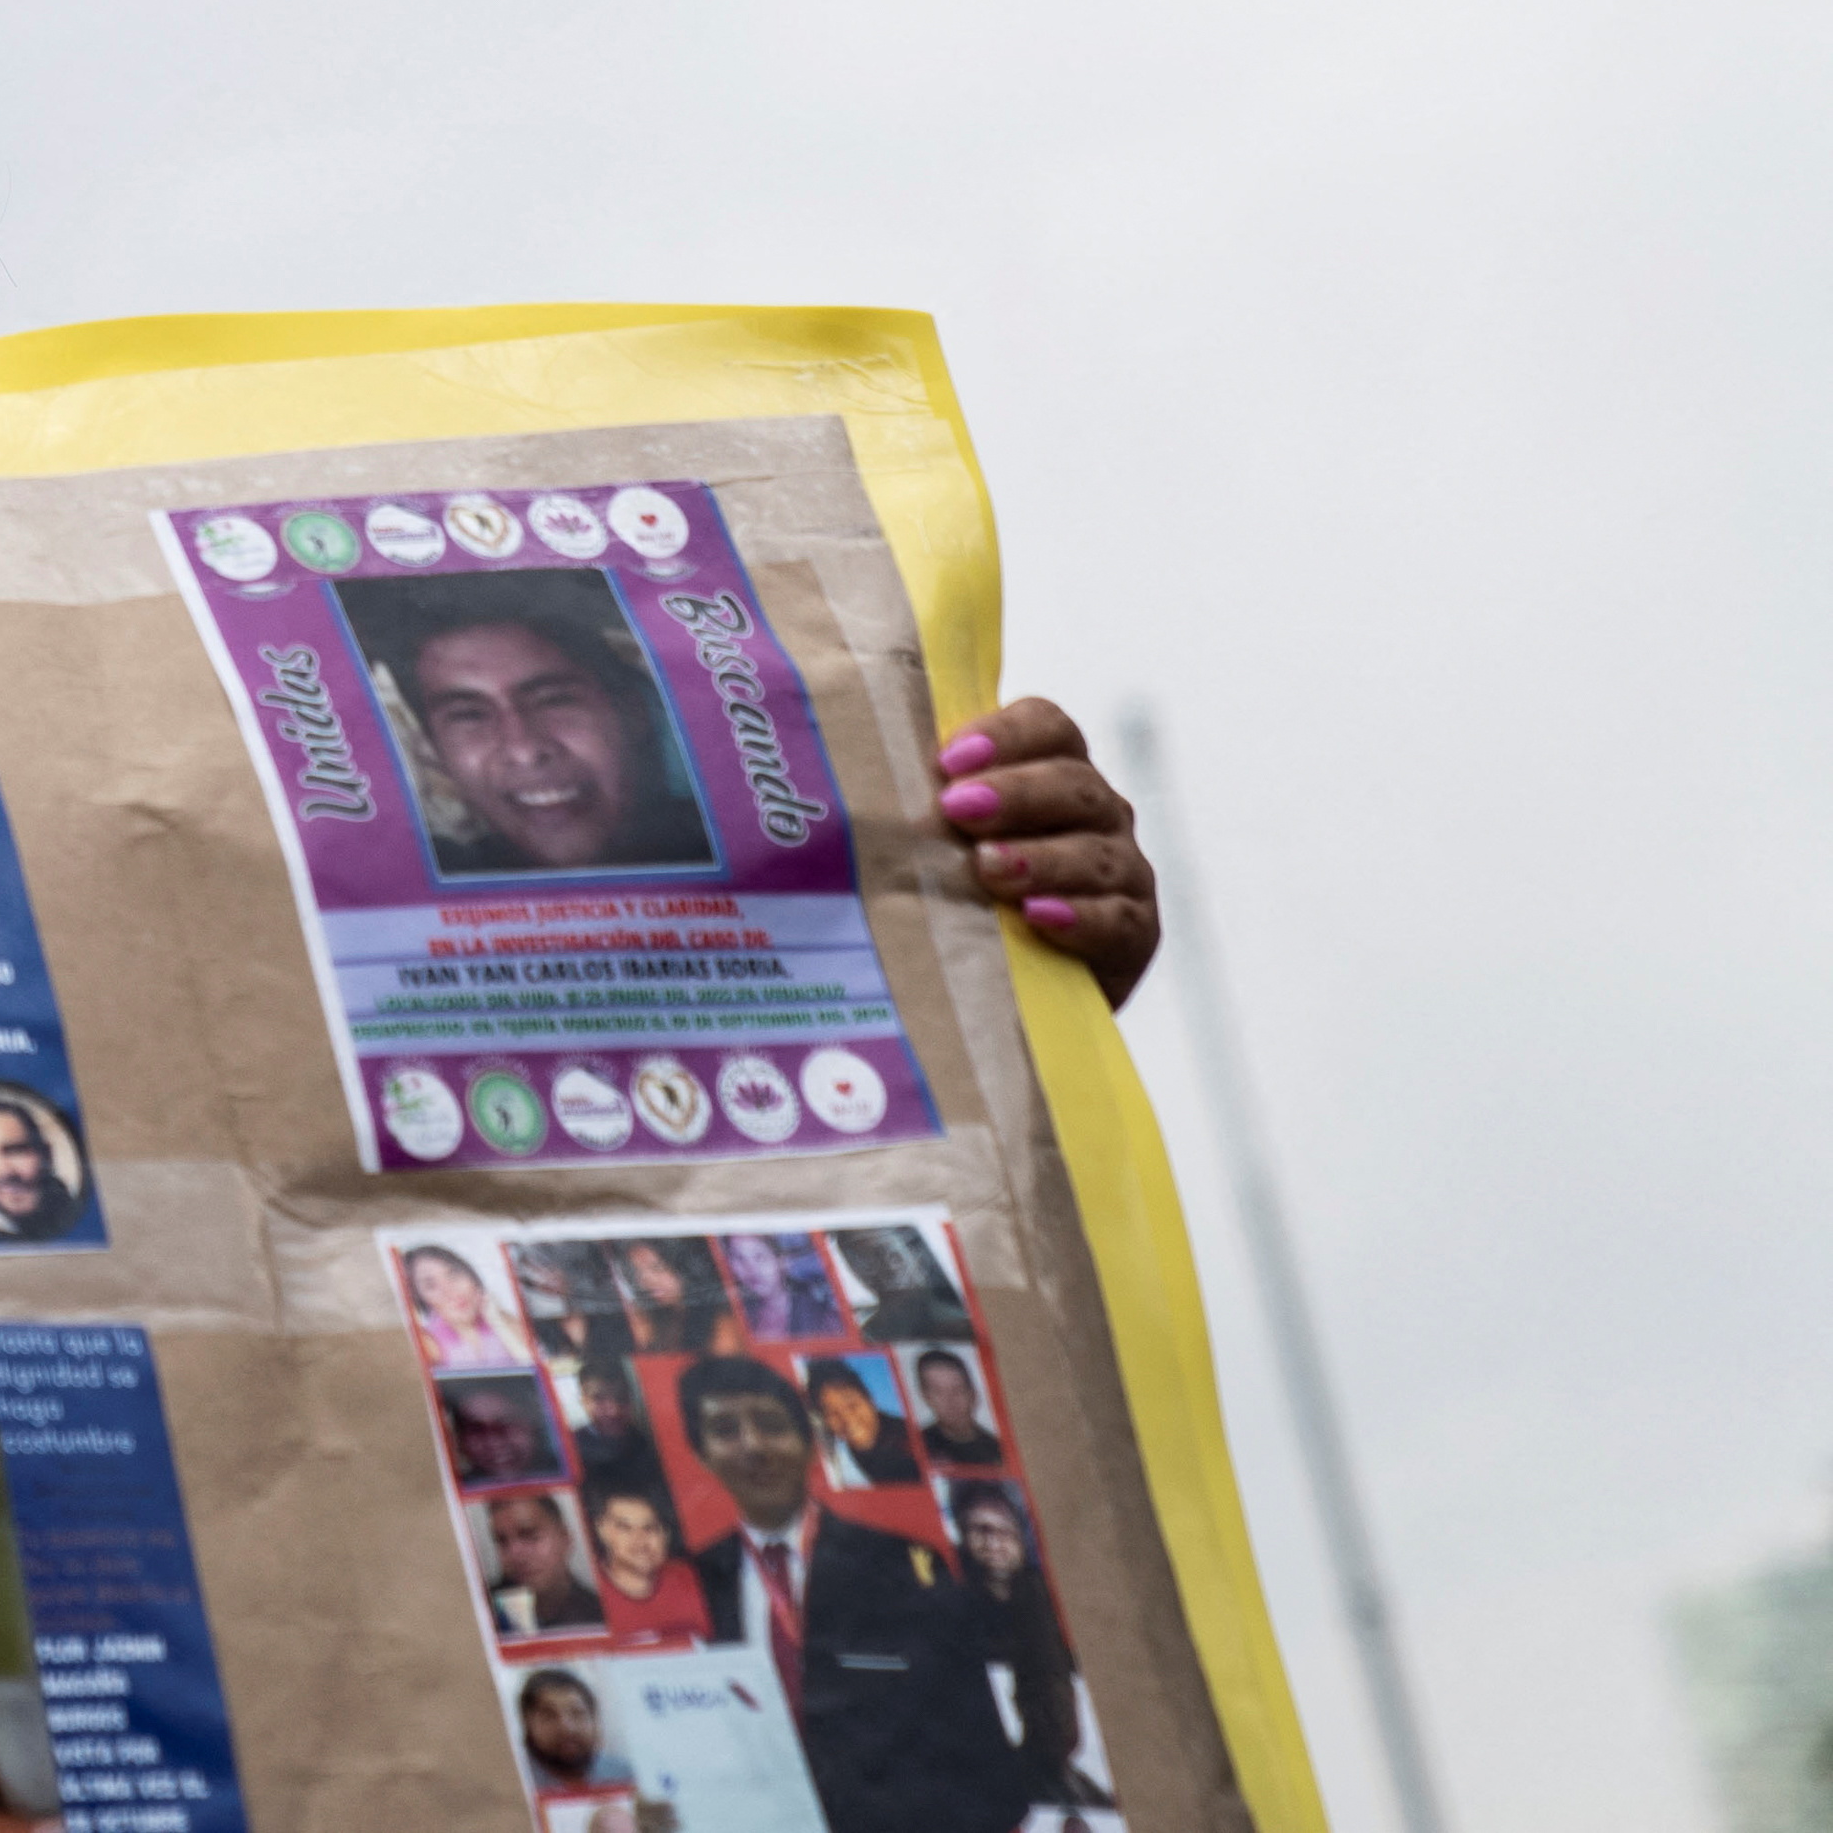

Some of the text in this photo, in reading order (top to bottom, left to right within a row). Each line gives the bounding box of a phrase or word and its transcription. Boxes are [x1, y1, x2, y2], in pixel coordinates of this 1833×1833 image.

[257, 641, 378, 824] Unidas
[659, 587, 831, 851] Buscando
[534, 900, 620, 927] JUSTICIA
[622, 898, 635, 916] Y
[427, 937, 457, 957] EN
[458, 935, 487, 957] LA
[648, 929, 682, 952] DEL
[685, 927, 739, 951] CASO
[396, 963, 459, 989] IVAN
[463, 960, 518, 986] YAN
[521, 957, 618, 984] CARLOS
[60, 1330, 113, 1360] que
[113, 1327, 145, 1357] la
[106, 1365, 139, 1389] se
[0, 1424, 136, 1456] costumbre
